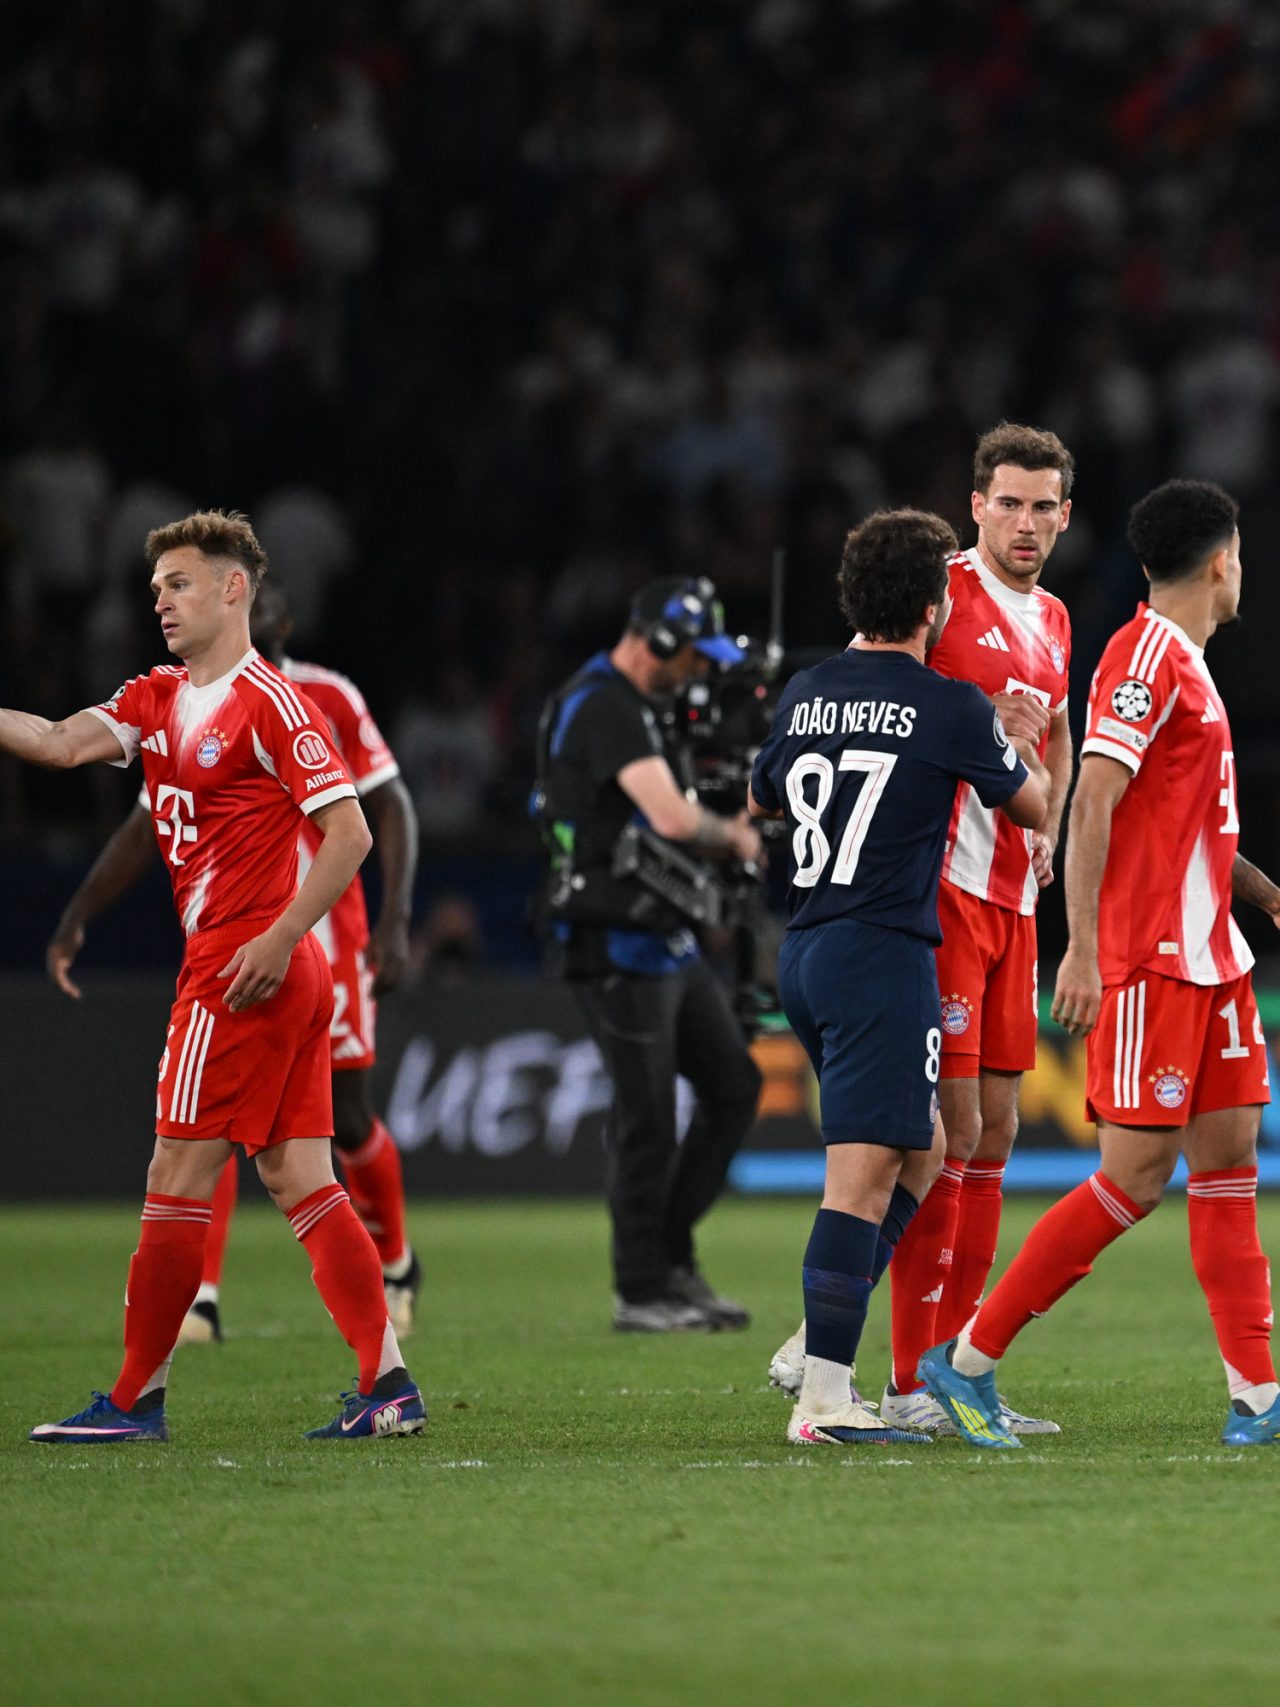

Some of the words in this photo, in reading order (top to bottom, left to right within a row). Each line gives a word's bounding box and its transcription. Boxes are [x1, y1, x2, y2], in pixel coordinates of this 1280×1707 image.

[787, 697, 837, 736] JOÃO
[841, 701, 917, 738] NEVES
[305, 769, 345, 792] Allianz
[786, 750, 899, 888] 87
[925, 1028, 941, 1083] 8
